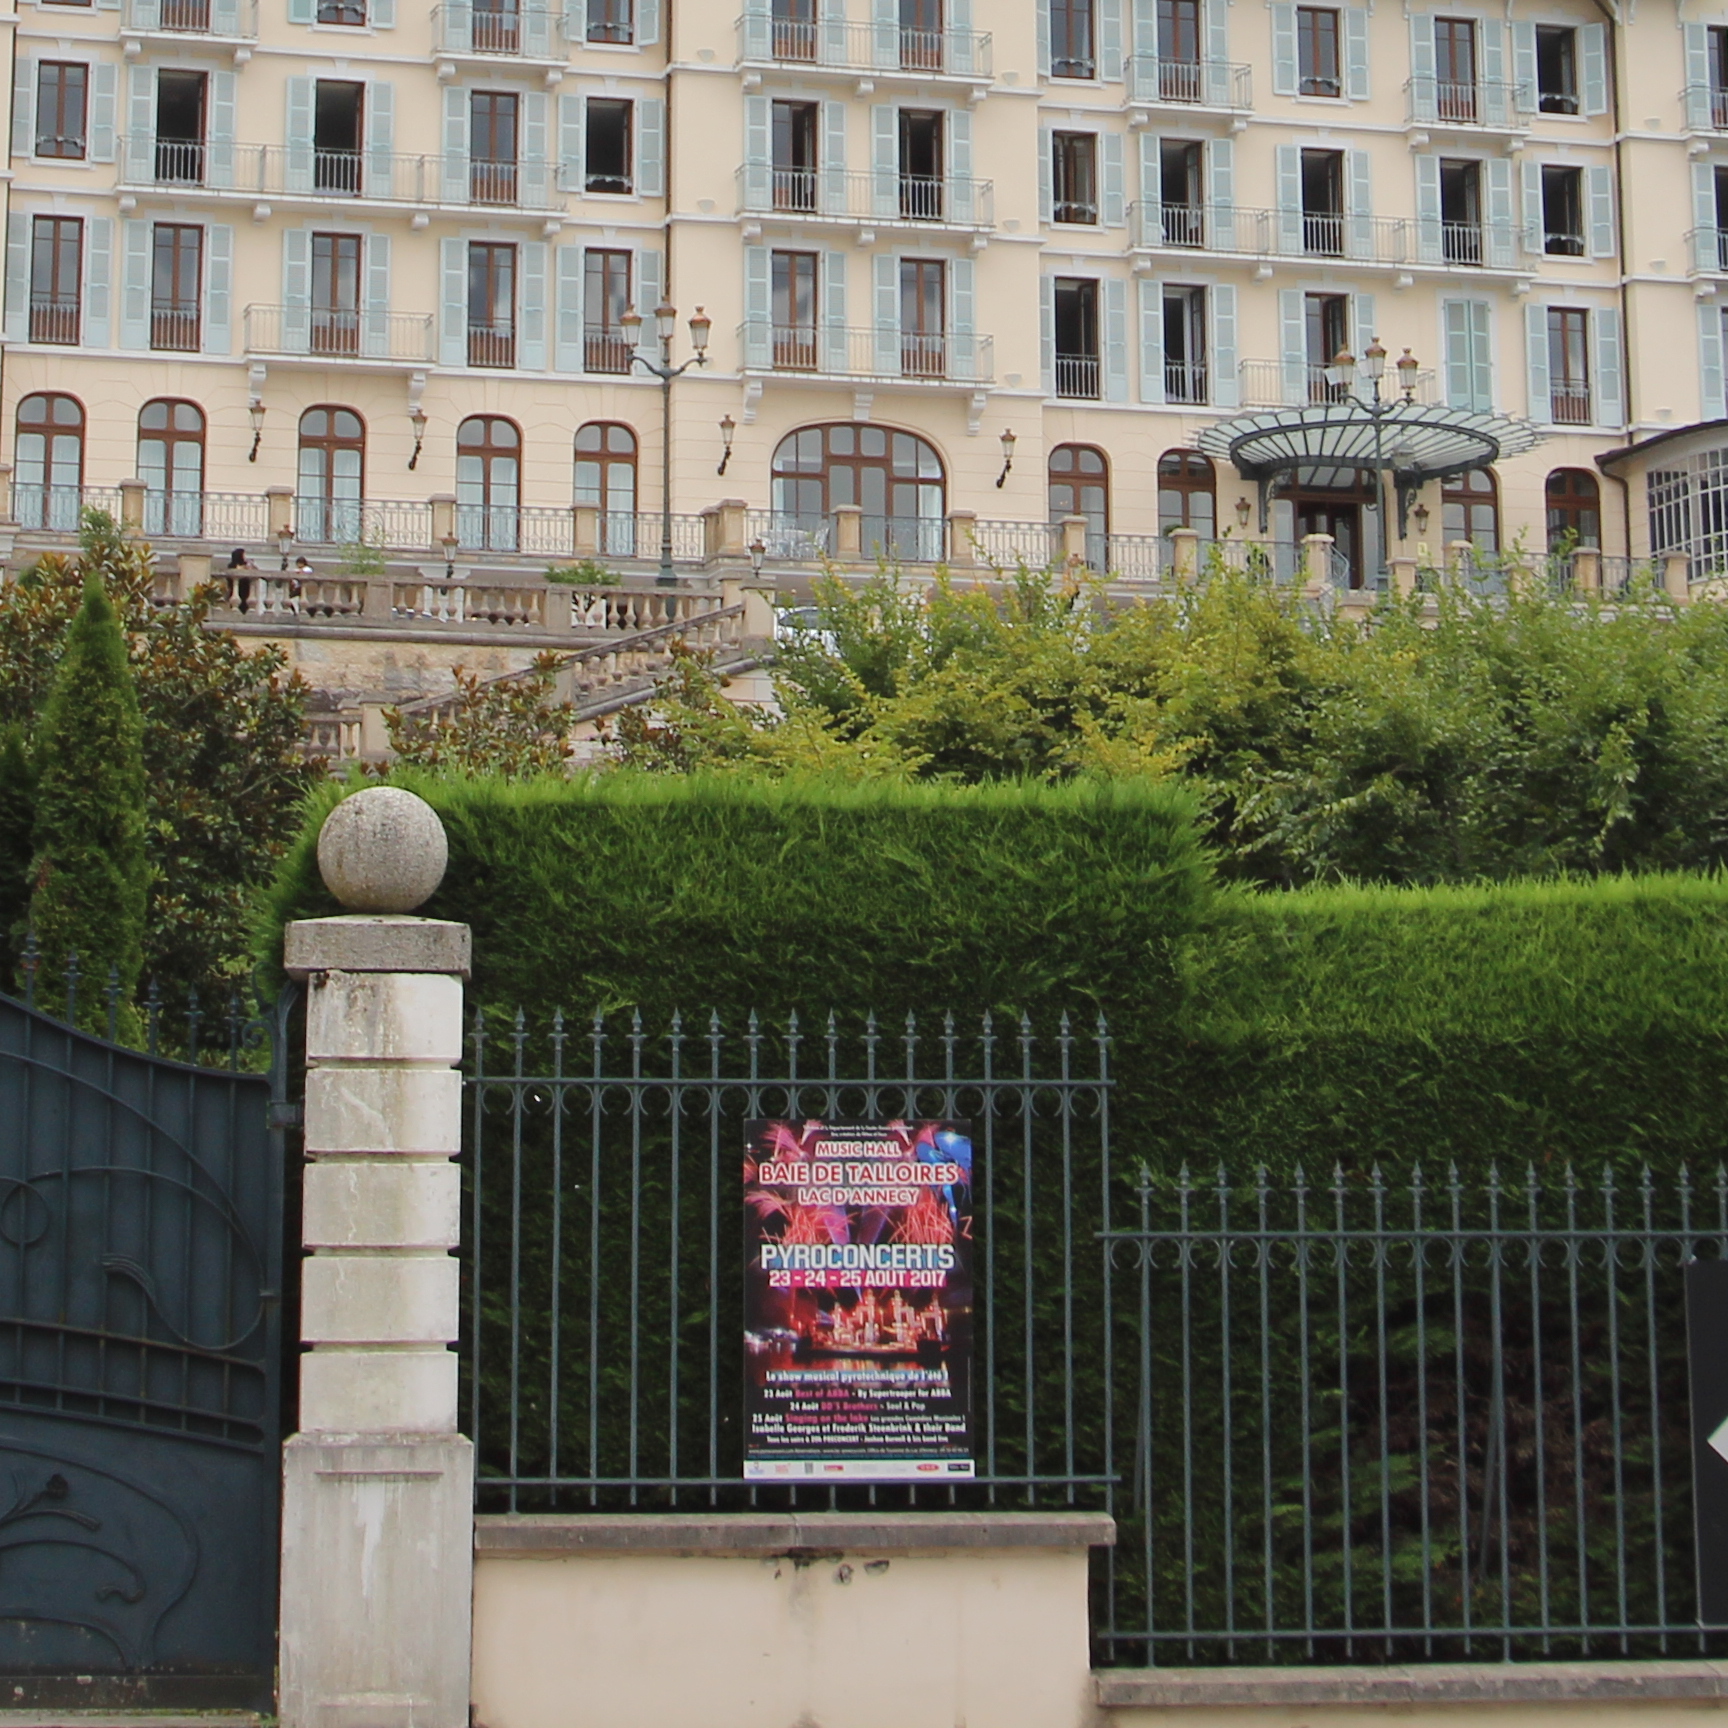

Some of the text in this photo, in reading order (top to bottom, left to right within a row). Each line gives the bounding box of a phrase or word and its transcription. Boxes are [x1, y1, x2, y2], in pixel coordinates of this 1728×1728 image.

[816, 1141, 902, 1158] MUSIC HALL
[759, 1162, 959, 1184] BAIE DE TALLOIRES
[798, 1187, 920, 1206] LAC D'ANNECY
[761, 1243, 956, 1269] PYROCONCERTS
[769, 1270, 791, 1287] 23
[804, 1270, 826, 1287] 24
[840, 1270, 862, 1287] 25
[909, 1270, 947, 1287] 2017
[766, 1370, 776, 1381] Le
[778, 1370, 802, 1381] show
[804, 1370, 839, 1381] musical
[841, 1370, 905, 1383] pyrotechnique
[908, 1370, 919, 1381] de
[815, 1388, 824, 1398] of
[827, 1388, 849, 1398] ABBA
[857, 1388, 867, 1399] By
[869, 1388, 916, 1399] Supertrooper
[918, 1388, 929, 1397] for
[931, 1388, 951, 1397] ABBA
[790, 1402, 800, 1411] 24
[886, 1401, 902, 1410] Soul
[904, 1401, 909, 1410] &
[911, 1401, 925, 1411] Pop
[752, 1413, 762, 1423] 25
[785, 1413, 818, 1424] Singing
[820, 1415, 831, 1423] on
[833, 1413, 847, 1422] the
[850, 1413, 869, 1423] lake
[752, 1423, 785, 1433] Isabelle
[787, 1423, 820, 1435] Georges
[822, 1423, 831, 1433] et
[869, 1422, 913, 1433] Steenbrink
[914, 1422, 921, 1433] &
[923, 1422, 943, 1432] their
[945, 1422, 966, 1432] Band
